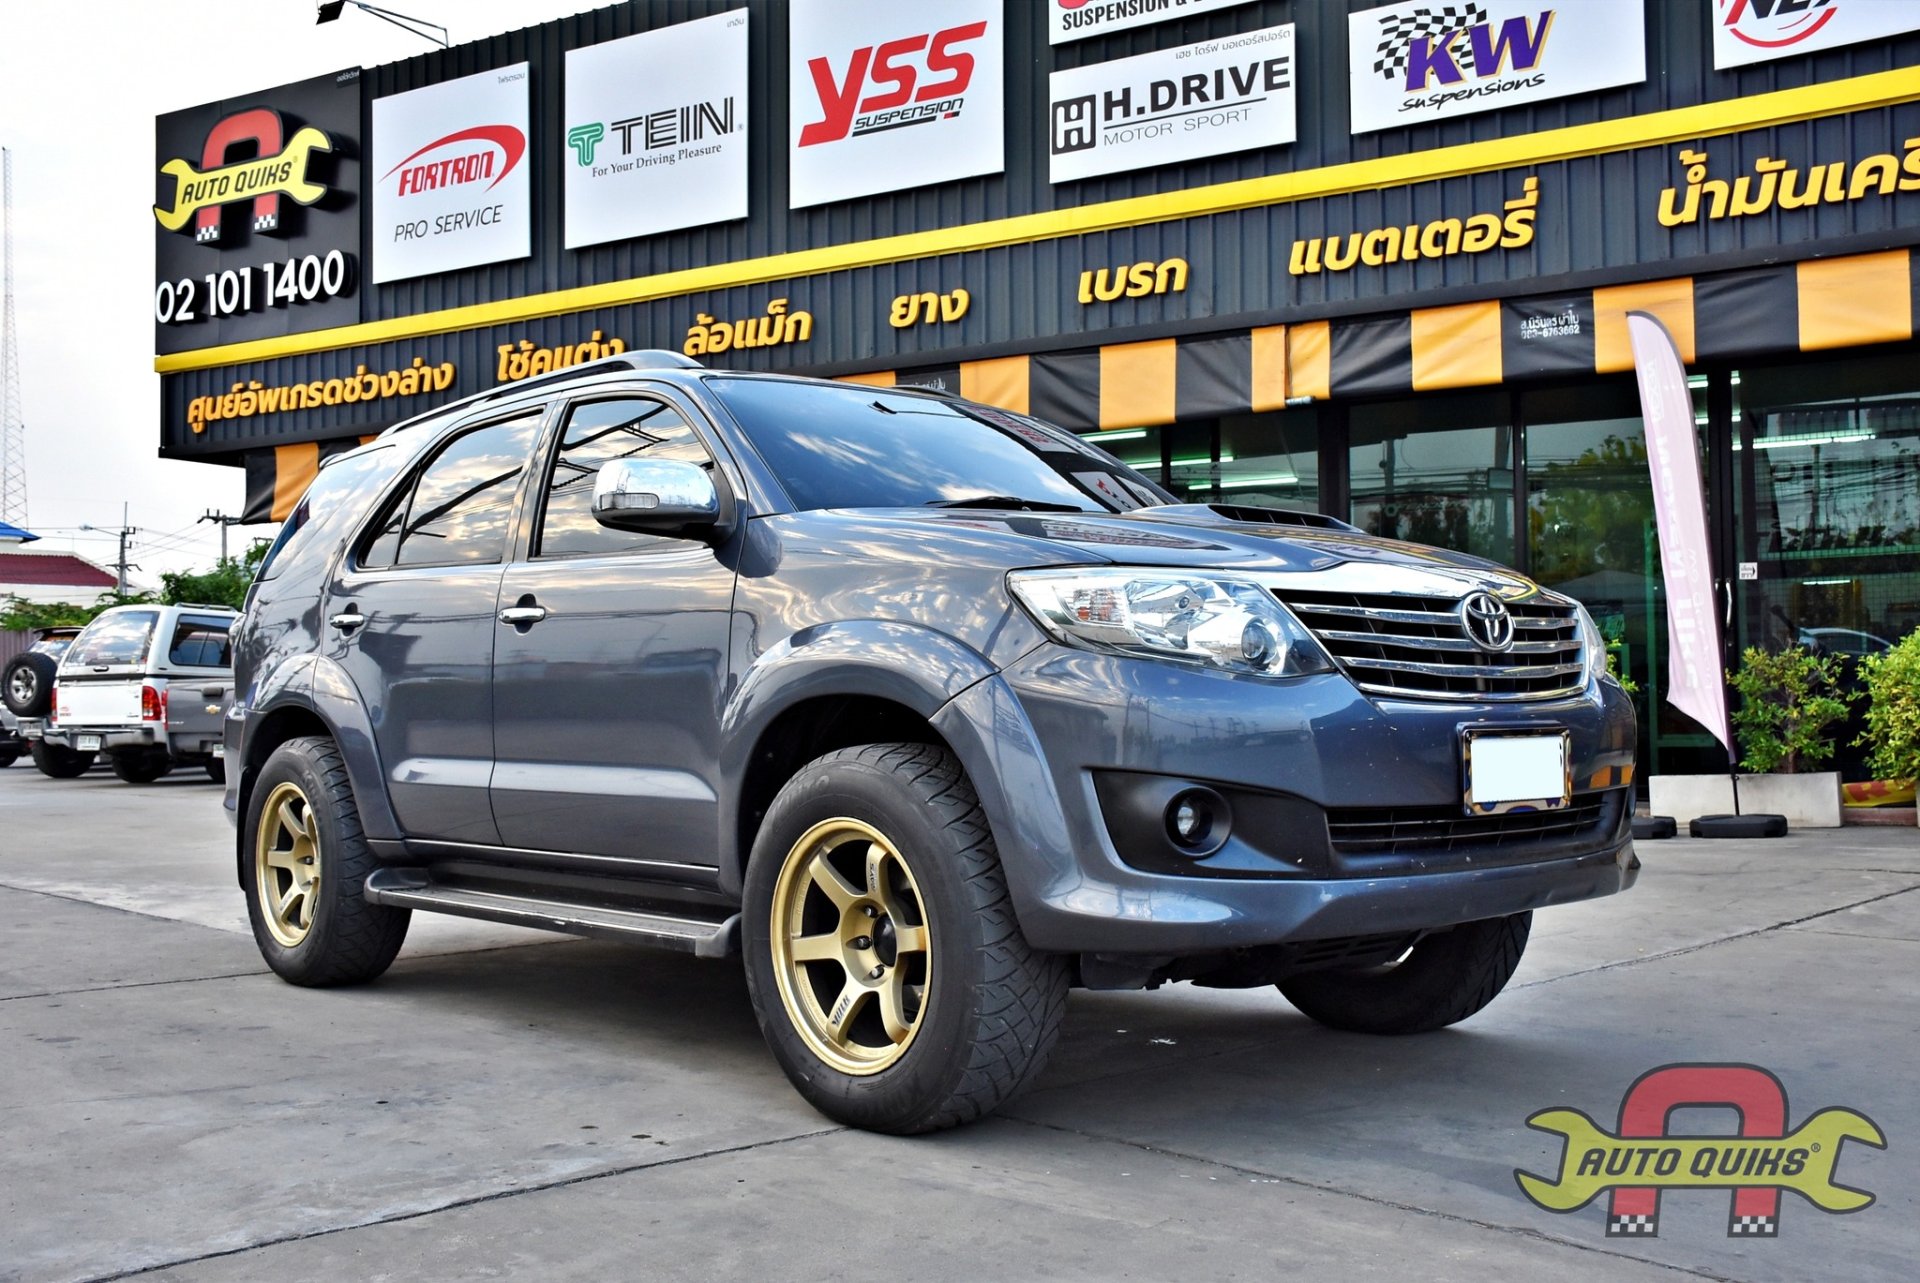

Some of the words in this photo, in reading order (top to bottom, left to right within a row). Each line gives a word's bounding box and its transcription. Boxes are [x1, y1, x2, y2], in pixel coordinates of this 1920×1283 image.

[1405, 10, 1556, 92] KW
[1103, 56, 1291, 122] H.DRIVE
[1398, 73, 1545, 112] suspensions
[611, 96, 734, 155] TEIN
[854, 97, 964, 130] SUSPENSION
[1103, 122, 1173, 146] MOTOR
[1184, 108, 1252, 132] SPORT
[398, 150, 495, 197] FORTRON
[592, 168, 608, 177] For
[611, 162, 634, 174] Your
[636, 154, 676, 169] Driving
[678, 144, 722, 161] Pleasure
[182, 175, 231, 204] AUTO
[394, 219, 429, 243] PRO
[434, 204, 504, 235] SERVICE
[1288, 176, 1539, 276] แบตเตอรี่
[156, 278, 195, 323] 02
[205, 266, 251, 316] 101
[263, 249, 345, 307] 1400
[1077, 257, 1189, 304] เบรก
[683, 298, 813, 357] ล้อแม็ก
[889, 288, 969, 328] ยาง
[187, 356, 456, 434] ศูนย์อัพเกรดช่วงล่าง
